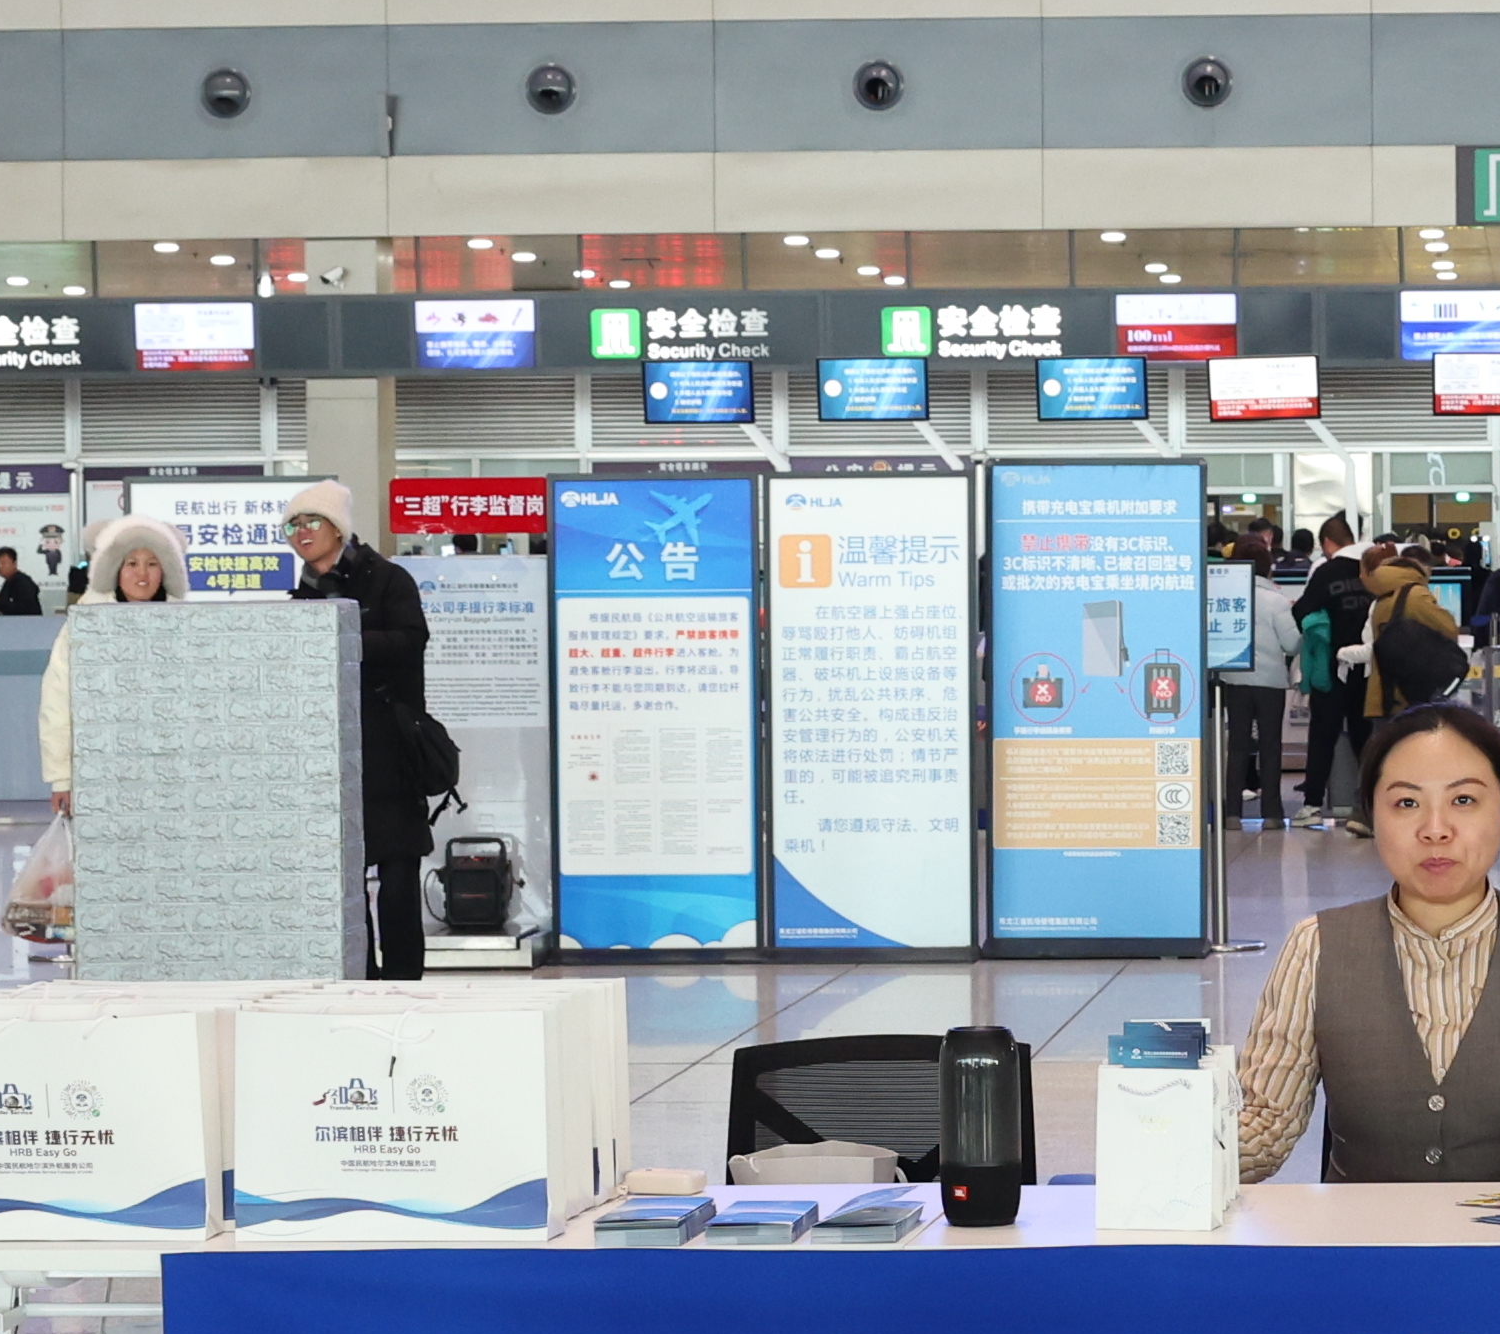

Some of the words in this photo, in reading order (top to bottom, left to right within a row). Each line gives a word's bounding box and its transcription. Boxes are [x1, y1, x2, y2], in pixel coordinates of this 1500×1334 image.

[646, 306, 771, 340] 安全检查
[936, 304, 1062, 339] 安全检查
[24, 347, 83, 367] Check
[646, 341, 713, 363] Security
[714, 340, 771, 359] Check
[938, 339, 1004, 362] Security
[1006, 338, 1063, 357] Check
[174, 500, 238, 516] 民航出行
[581, 491, 619, 506] HLJA
[809, 497, 843, 508] HLJA
[1021, 499, 1177, 516] 携带充电宝乘机附加要求
[837, 534, 961, 566] 温馨提示
[188, 556, 280, 572] 安检快捷高效
[604, 541, 701, 582] 公告
[206, 573, 262, 589] 4号通道
[837, 571, 892, 587] Warm
[897, 570, 936, 590] Tips
[1001, 574, 1195, 591] 或批次的充电宝乘坐境内航班
[44, 1127, 116, 1147] 捷行无忧
[8, 1147, 33, 1158] HRB
[35, 1147, 61, 1161] Easy
[63, 1147, 78, 1158] Go
